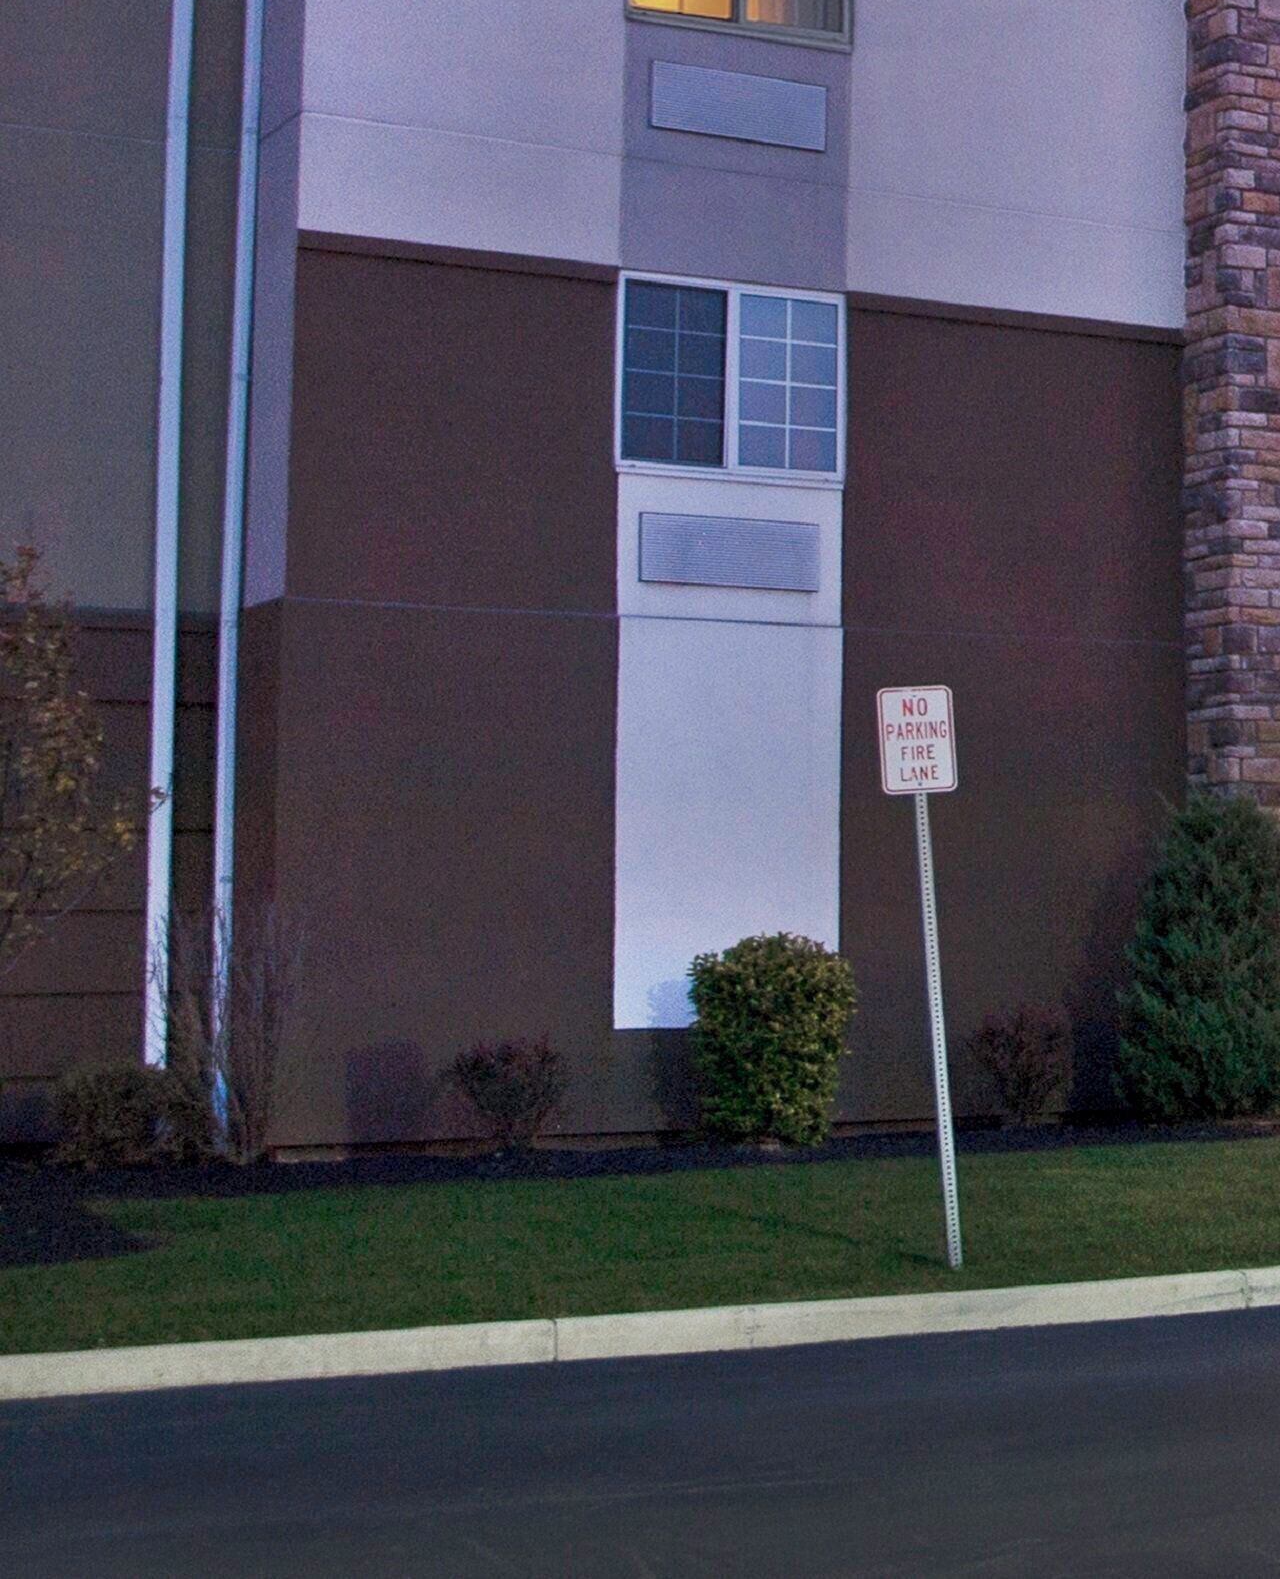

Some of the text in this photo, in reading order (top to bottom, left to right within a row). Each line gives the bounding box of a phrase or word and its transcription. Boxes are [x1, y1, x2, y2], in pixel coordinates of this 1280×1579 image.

[902, 698, 928, 716] NO
[885, 720, 947, 741] PARKING
[901, 744, 936, 761] FIRE
[901, 765, 940, 782] LANE
